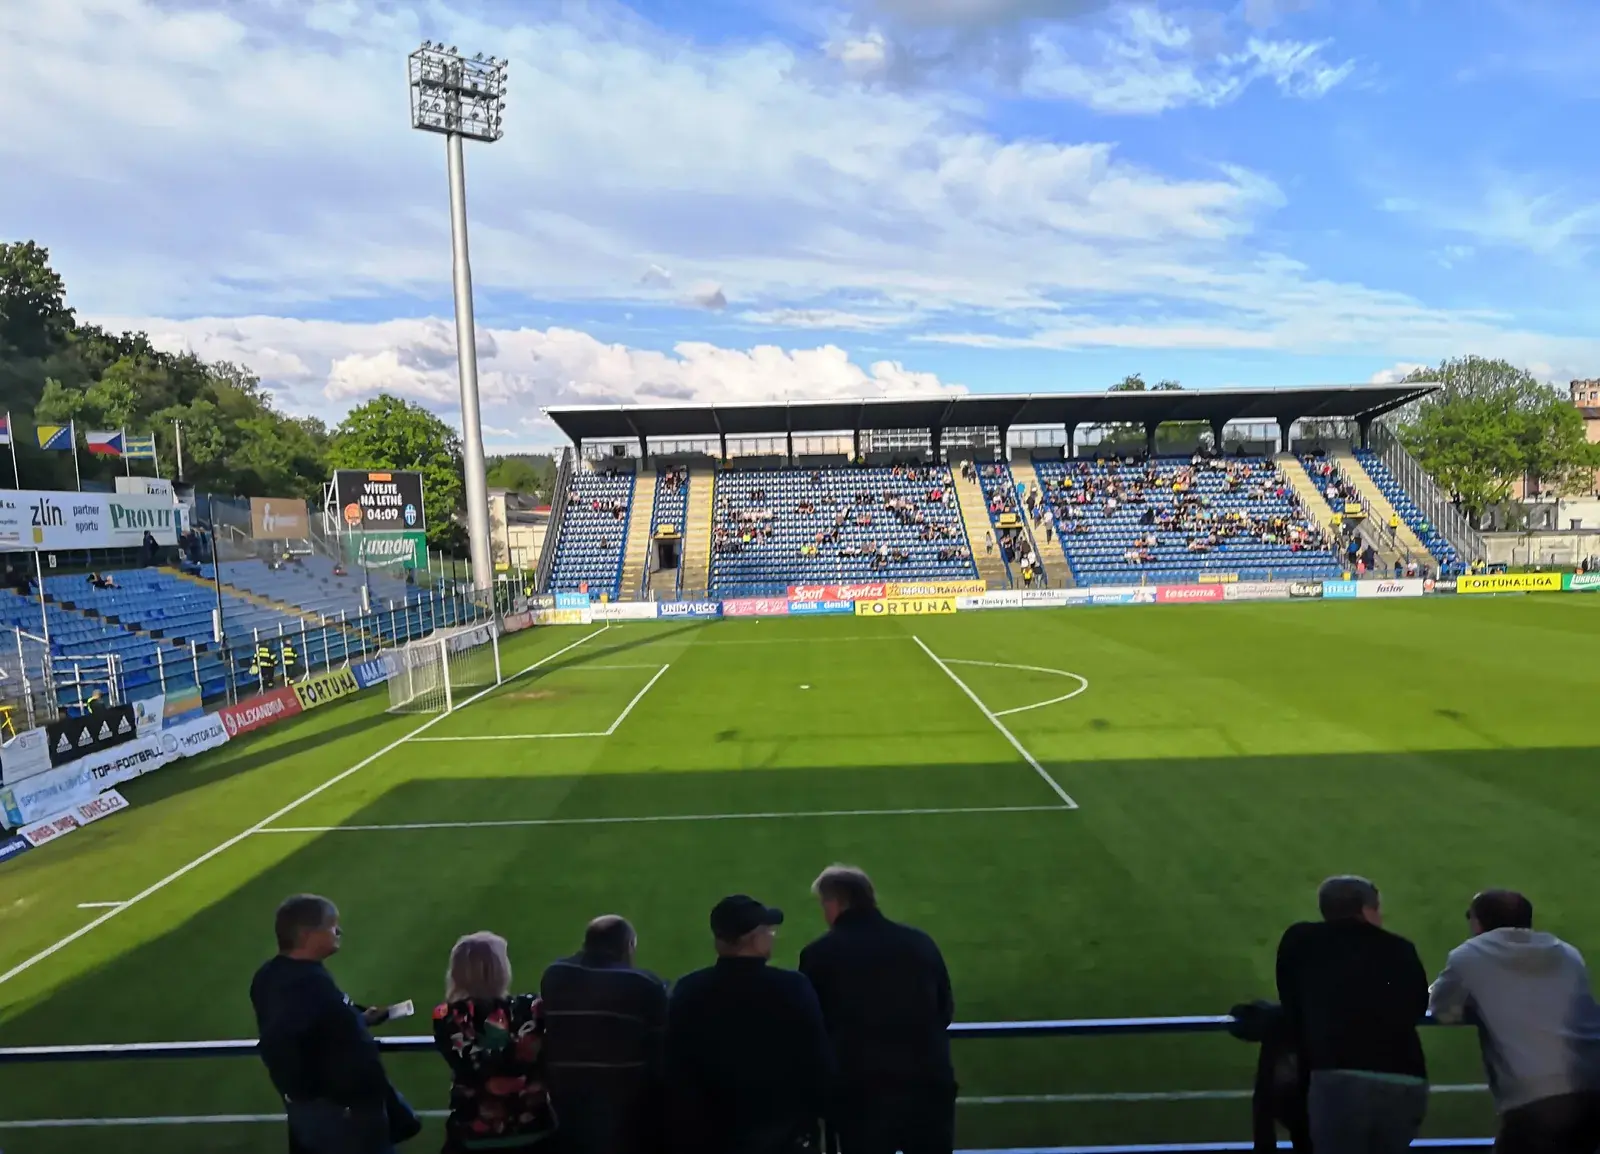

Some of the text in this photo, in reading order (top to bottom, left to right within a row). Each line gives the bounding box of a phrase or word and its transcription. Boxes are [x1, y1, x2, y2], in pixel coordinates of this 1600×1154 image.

[364, 482, 397, 494] VÍTEJTE
[361, 493, 402, 506] NA LETNÉ
[30, 498, 62, 526] zlín
[73, 504, 99, 516] partner
[109, 503, 171, 528] PROVIT
[367, 508, 398, 520] 04:09
[76, 520, 98, 534] sportu
[860, 601, 951, 614] FORTUNA
[297, 673, 355, 706] FORTUNA
[236, 698, 285, 728] ALEXANDRIA
